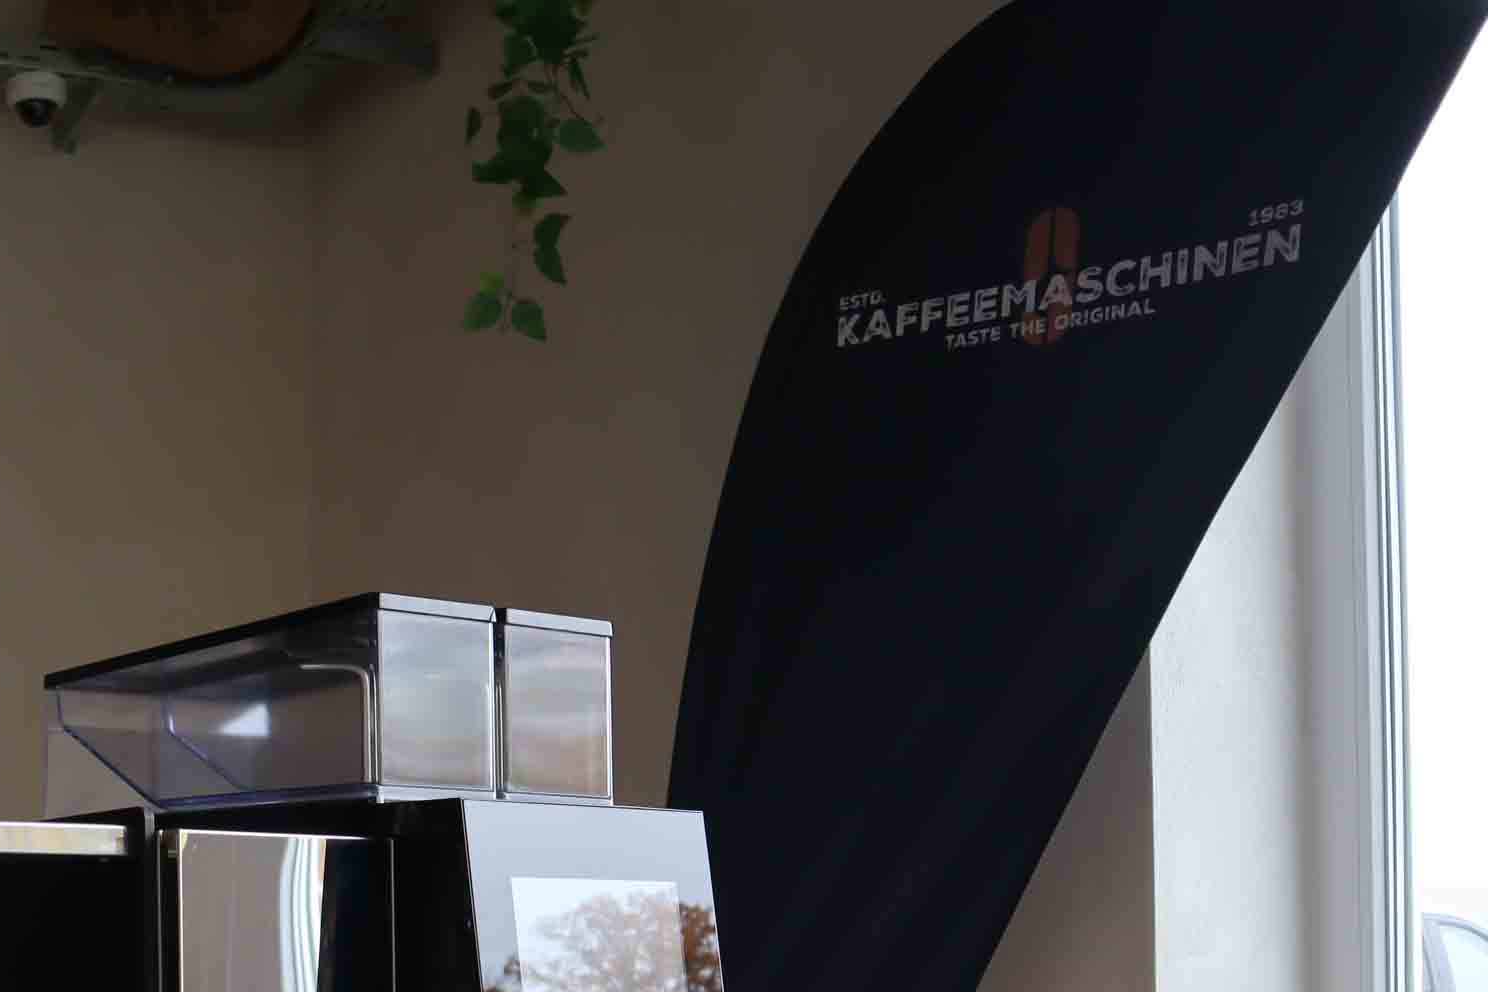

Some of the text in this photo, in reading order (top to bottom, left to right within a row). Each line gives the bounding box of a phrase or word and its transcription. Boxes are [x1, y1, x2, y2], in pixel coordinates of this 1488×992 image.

[1249, 199, 1304, 227] 1983
[837, 223, 1302, 348] KAFFEEMASCHINEN
[945, 298, 1156, 352] TASTE THE ORIGINAL
